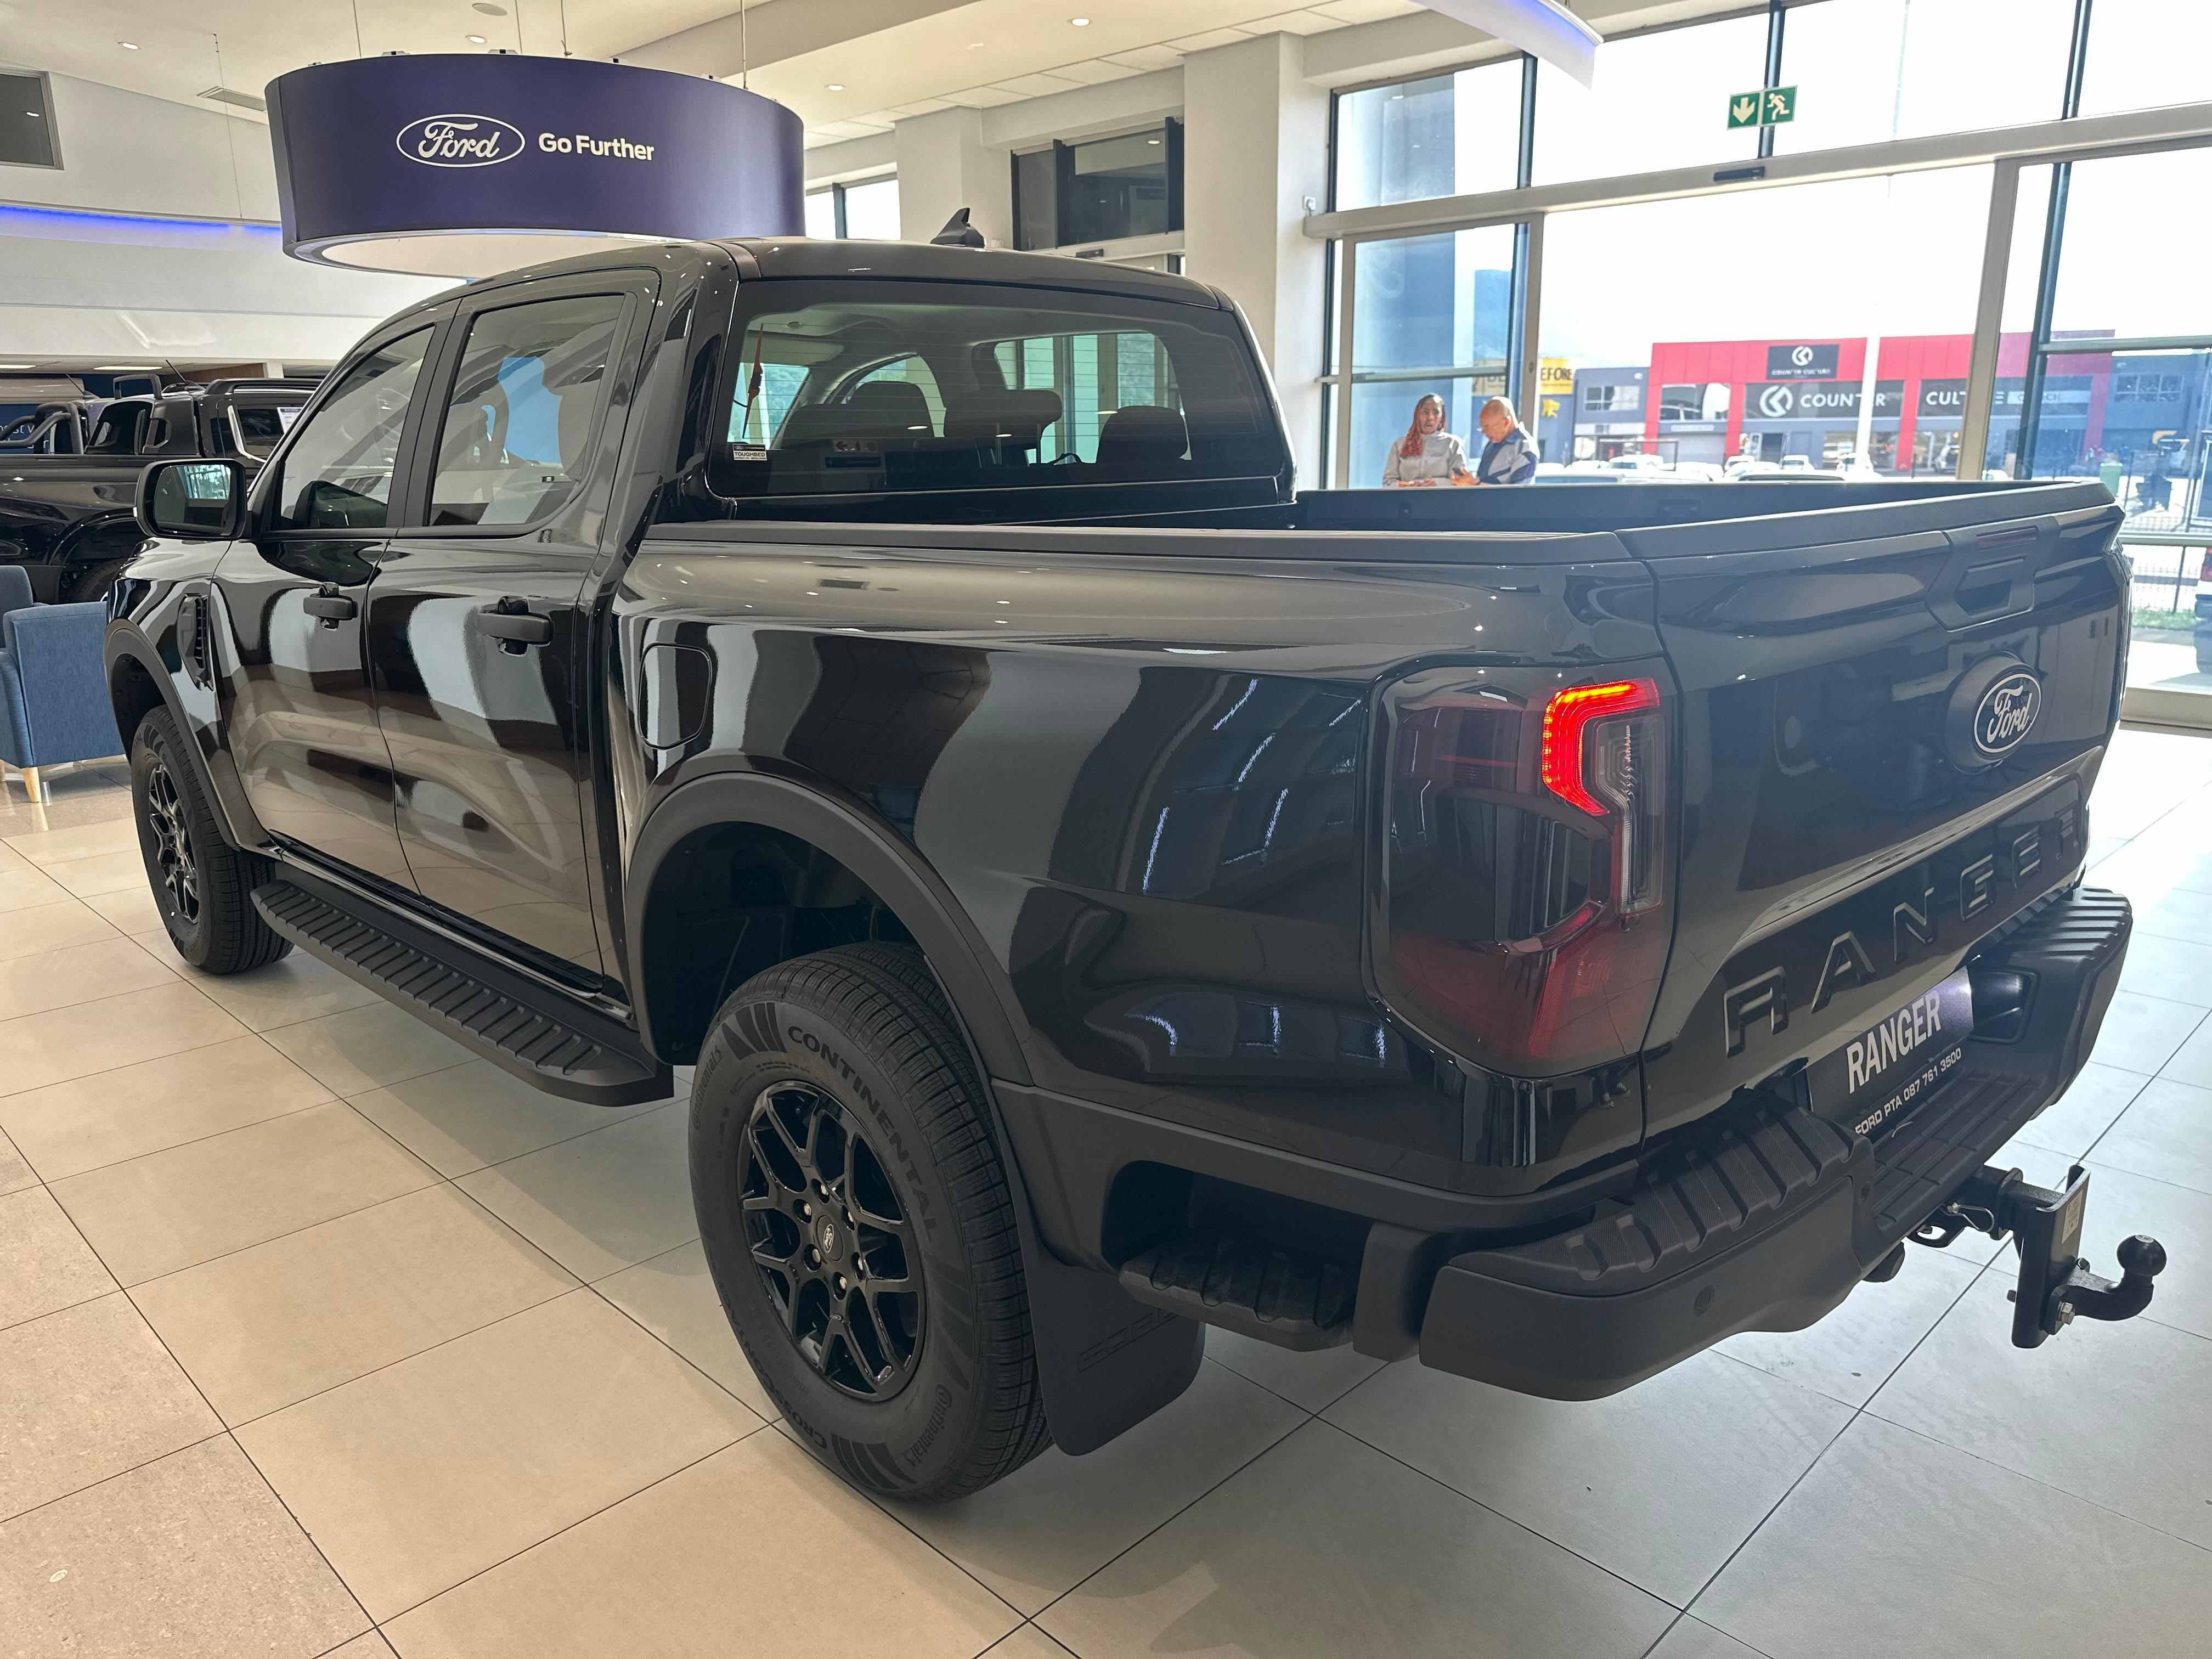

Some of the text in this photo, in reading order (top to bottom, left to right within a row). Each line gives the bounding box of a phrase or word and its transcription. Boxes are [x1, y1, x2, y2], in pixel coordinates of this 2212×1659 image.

[418, 121, 654, 161] Ford Go Further
[1799, 393, 1886, 408] COUNR
[1987, 685, 2033, 743] Ford
[1723, 809, 2077, 1059] RANGER
[1847, 990, 1941, 1094] RANGER
[788, 1025, 937, 1243] CONTINENTAL
[1855, 1047, 1962, 1135] FORD PTA 087 761 3500
